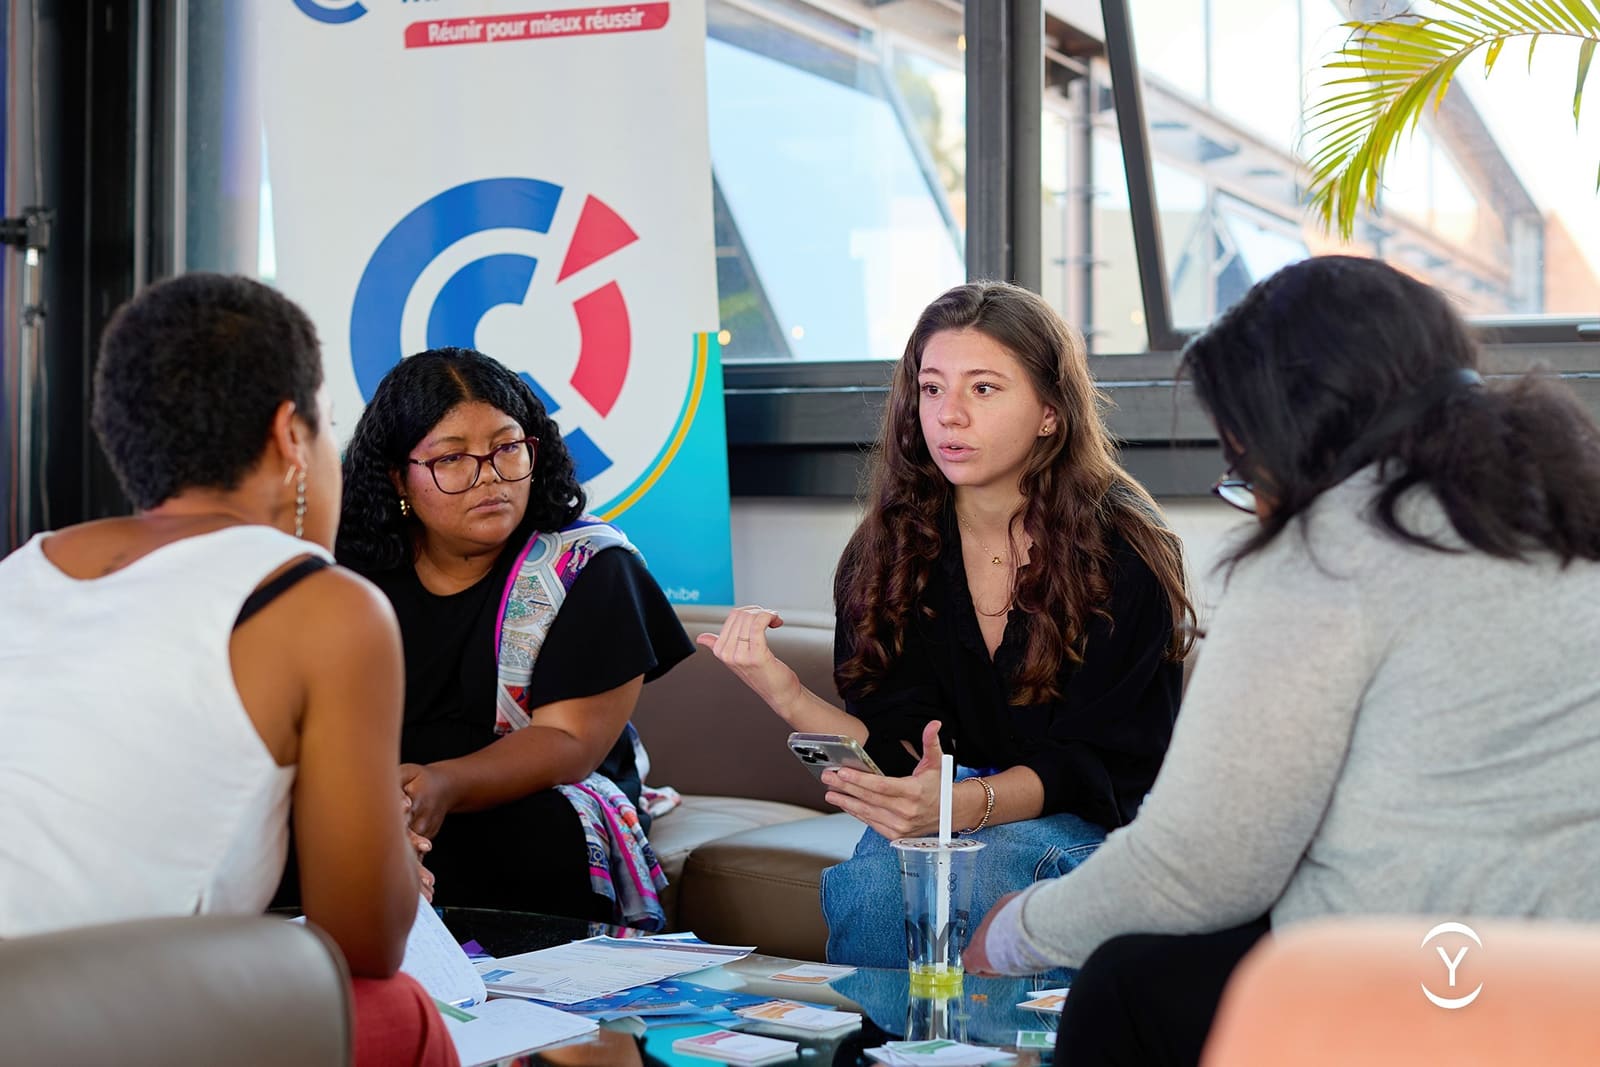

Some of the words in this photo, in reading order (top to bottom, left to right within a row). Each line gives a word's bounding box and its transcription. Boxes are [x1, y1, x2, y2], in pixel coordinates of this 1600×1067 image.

[427, 19, 484, 43] Réunir
[486, 20, 528, 42] pour
[530, 13, 582, 34] mieux
[584, 7, 645, 30] réussir
